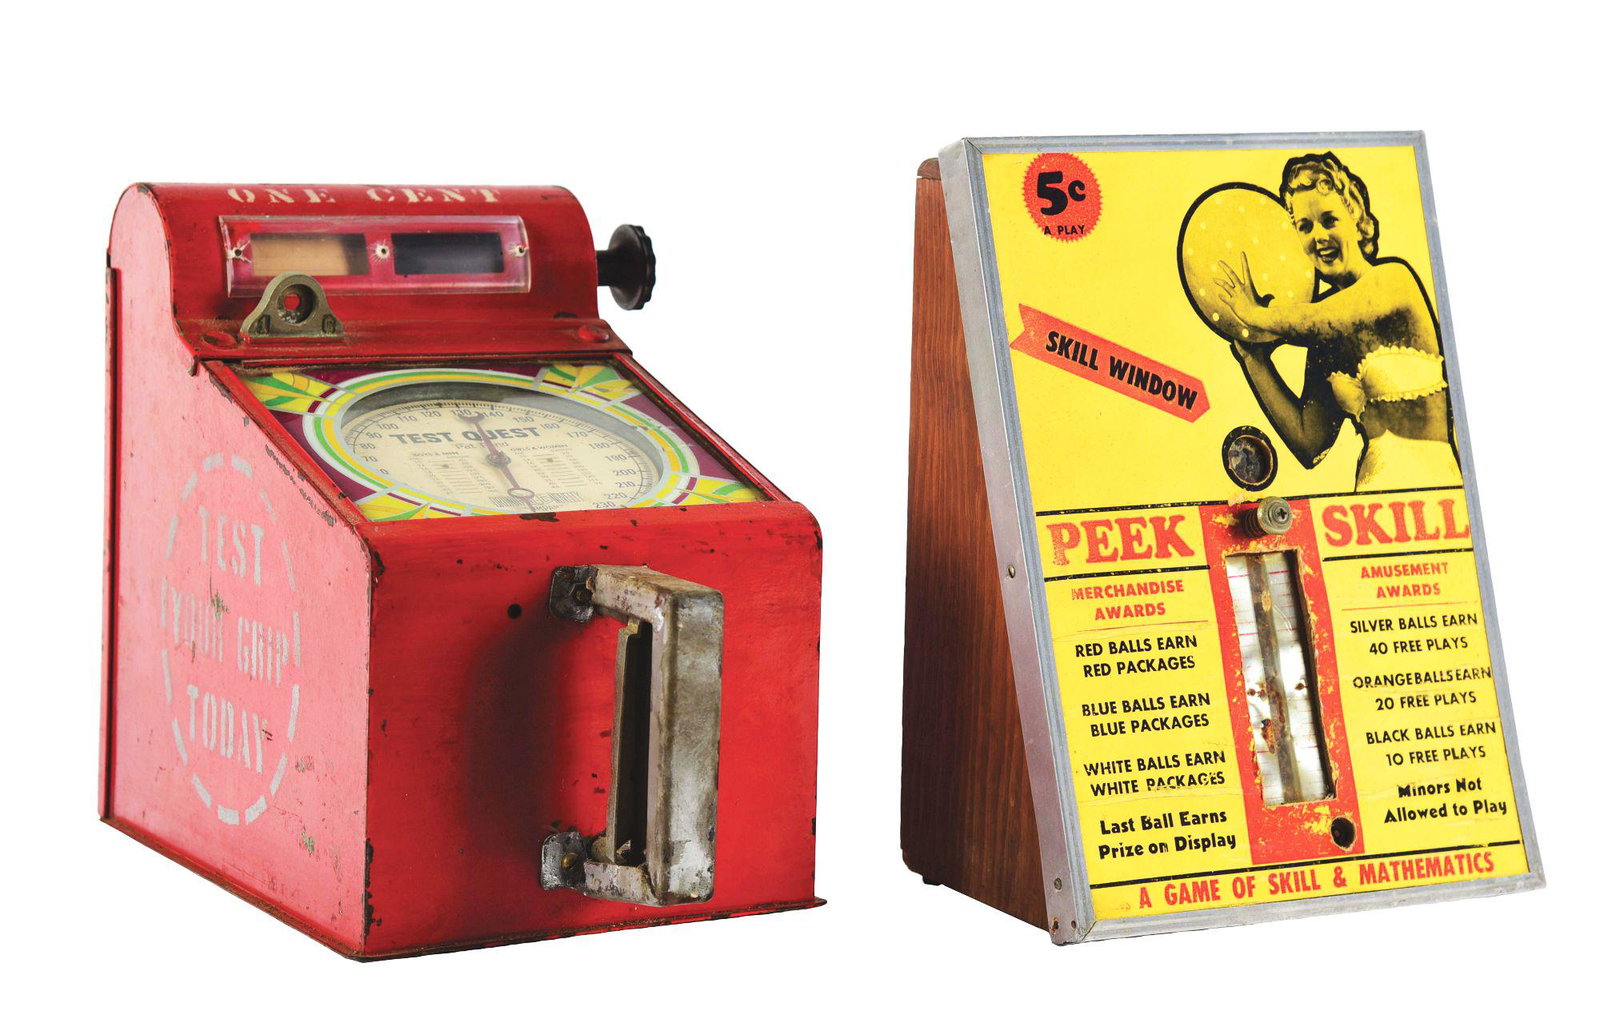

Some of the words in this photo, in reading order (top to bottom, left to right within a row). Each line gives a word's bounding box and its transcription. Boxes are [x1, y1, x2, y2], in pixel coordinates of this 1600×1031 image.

[227, 188, 336, 204] ONE
[366, 187, 501, 204] CENT
[1043, 225, 1052, 236] A
[1057, 224, 1086, 236] PLAY
[1045, 330, 1099, 371] SKILL
[1108, 355, 1198, 411] WINDOW
[377, 423, 399, 431] 100
[397, 415, 418, 423] 110
[512, 416, 535, 424] 150
[388, 431, 454, 444] TEST
[461, 426, 542, 442] QUEST
[588, 442, 611, 450] 180
[362, 455, 378, 463] 70
[605, 454, 627, 462] 190
[612, 468, 637, 477] 200
[615, 481, 636, 489] 210
[593, 501, 617, 509] 230
[603, 492, 628, 500] 220
[1046, 514, 1196, 566] PEEK
[1322, 499, 1471, 547] SKILL
[198, 505, 265, 586] TEST
[1361, 562, 1449, 579] AMUSEMENT
[1071, 579, 1185, 601] MERCHANDISE
[1376, 582, 1441, 599] AWARDS
[1095, 602, 1167, 621] AWARDS
[1350, 618, 1394, 634] SILVER
[1398, 615, 1438, 630] BALLS
[1443, 612, 1479, 627] EARN
[171, 587, 224, 663] YOUR
[236, 615, 288, 687] GRIP
[1075, 642, 1103, 658] RED
[1108, 638, 1153, 655] BALLS
[1157, 634, 1198, 650] EARN
[1369, 642, 1389, 656] 40
[1393, 639, 1423, 654] FREE
[1427, 636, 1468, 651] PLAYS
[1083, 663, 1112, 678] RED
[1117, 655, 1196, 676] PACKAGES
[1455, 666, 1492, 681] EARN
[1081, 701, 1117, 717] BLUE
[1121, 696, 1166, 713] BALLS
[1170, 692, 1211, 709] EARN
[1375, 697, 1395, 711] 20
[1400, 694, 1430, 709] FREE
[1434, 690, 1477, 706] PLAYS
[186, 684, 269, 775] TODAY
[1090, 721, 1126, 738] BLUE
[1131, 713, 1210, 734] PACKAGES
[1366, 728, 1410, 745] BLACK
[1415, 725, 1455, 741] BALLS
[1459, 721, 1497, 736] EARN
[1083, 759, 1132, 776] WHITE
[1137, 754, 1181, 772] BALLS
[1185, 750, 1227, 767] EARN
[1386, 753, 1404, 766] 10
[1409, 749, 1438, 764] FREE
[1443, 745, 1486, 761] PLAYS
[1090, 780, 1139, 797] WHITE
[1146, 771, 1226, 792] PACKAGES
[1397, 782, 1451, 798] Minors
[1455, 777, 1482, 793] Not
[1384, 803, 1448, 824] Allowed
[1452, 802, 1468, 816] to
[1473, 799, 1507, 816] Play
[1100, 818, 1136, 836] Last
[1140, 812, 1174, 831] Ball
[1179, 810, 1228, 827] Earns
[1098, 842, 1144, 860] Prize
[1148, 841, 1169, 854] on
[1174, 833, 1237, 853] Display
[1139, 886, 1153, 909] A
[1164, 879, 1220, 906] GAME
[1232, 875, 1256, 899] OF
[1268, 869, 1321, 895] SKILL
[1332, 866, 1347, 888] &
[1359, 851, 1495, 886] MATHEMATICS
